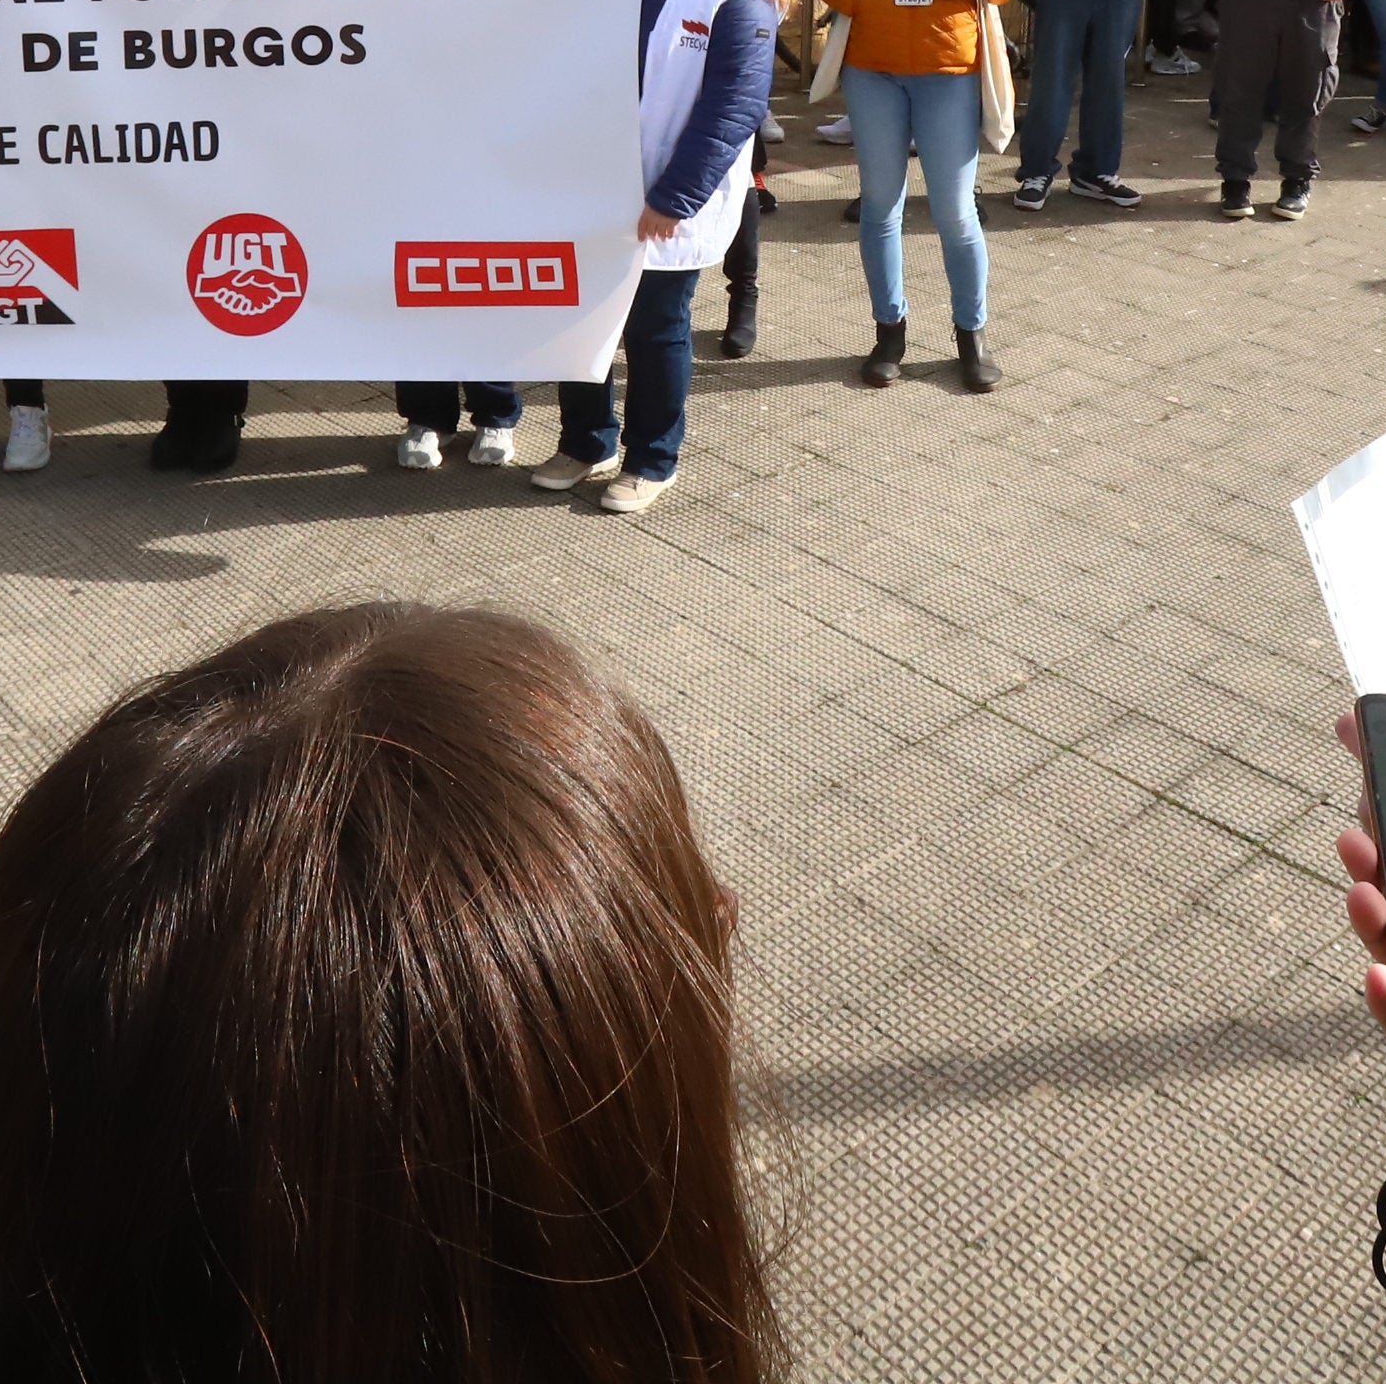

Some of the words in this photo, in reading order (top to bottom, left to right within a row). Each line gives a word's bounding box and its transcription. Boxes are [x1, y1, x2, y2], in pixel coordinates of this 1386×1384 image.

[21, 31, 99, 73] DE
[123, 23, 367, 70] BURGOS
[38, 120, 220, 165] CALIDAD
[203, 232, 289, 274] UGT
[407, 257, 565, 293] CCOO
